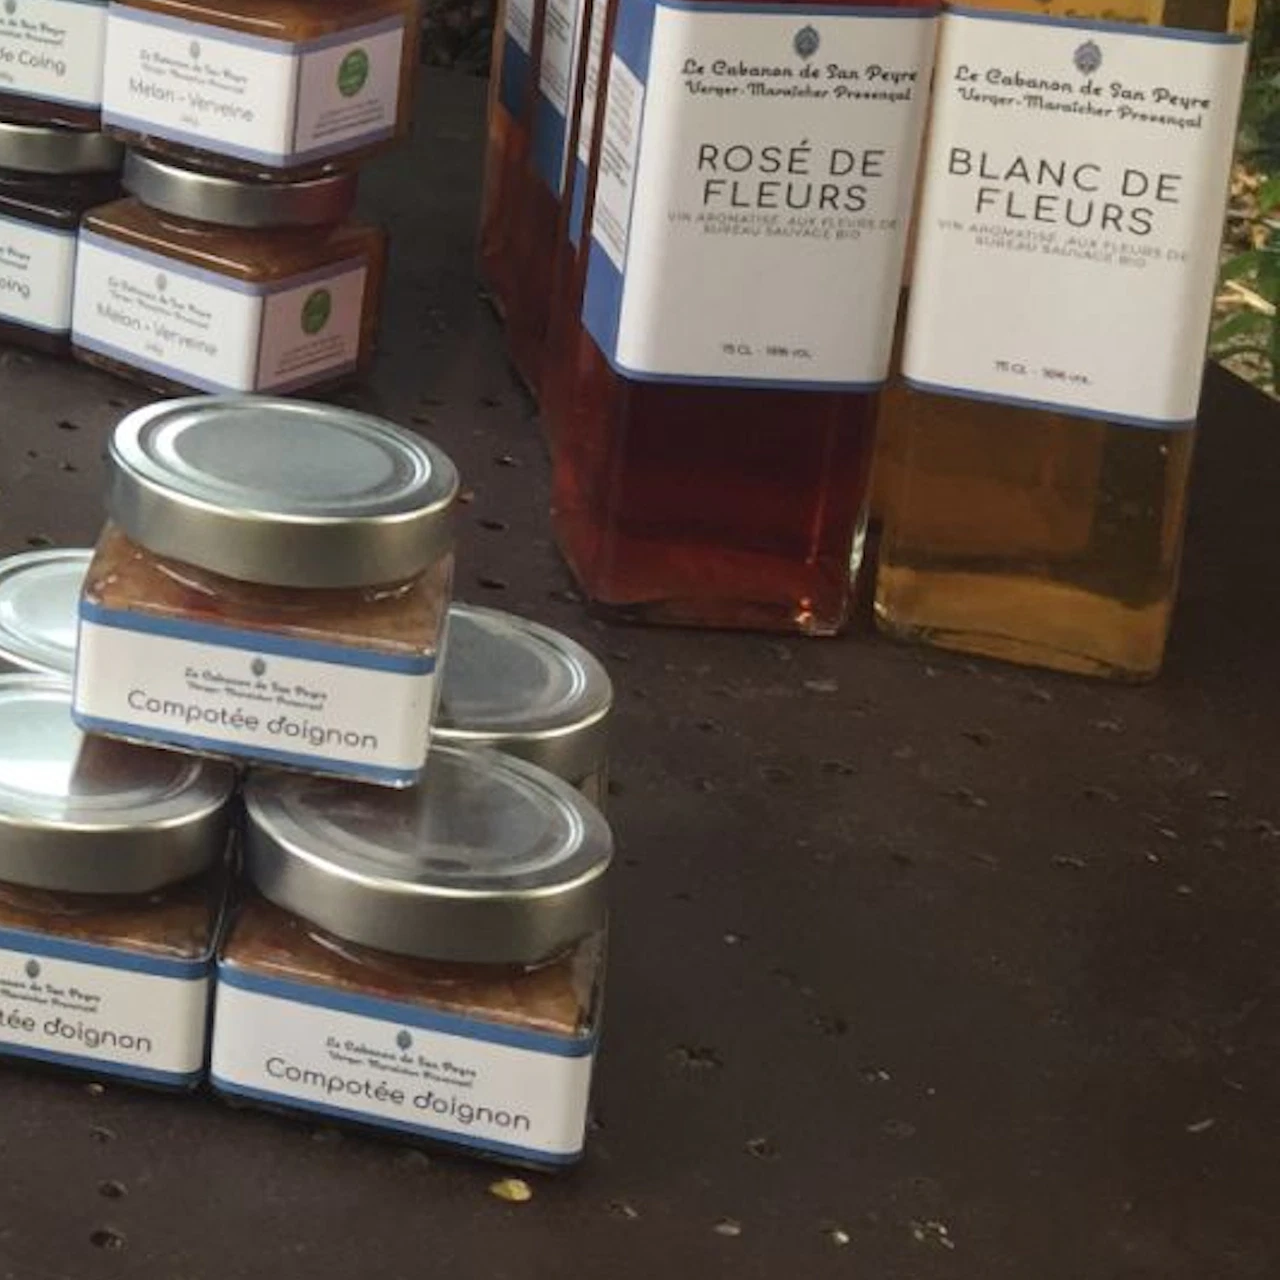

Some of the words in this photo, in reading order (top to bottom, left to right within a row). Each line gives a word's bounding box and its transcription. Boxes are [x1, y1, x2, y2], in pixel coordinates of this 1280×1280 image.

[18, 50, 66, 76] Coing
[682, 59, 704, 75] Le
[712, 60, 792, 77] Cabanon
[799, 63, 819, 79] de
[826, 64, 858, 81] San
[864, 64, 918, 84] Peyre
[954, 65, 979, 82] Le
[985, 68, 1073, 94] Cabanon
[1080, 80, 1102, 96] de
[1110, 82, 1145, 102] San
[1152, 87, 1211, 111] Peyre
[698, 139, 811, 175] ROSÉ
[829, 149, 886, 177] DE
[948, 147, 1102, 192] BLANC
[1121, 169, 1183, 203] DE
[704, 179, 867, 211] FLEURS
[976, 187, 1155, 236] FLEURS
[128, 689, 260, 730] Compotée
[265, 1056, 405, 1104] Compotée
